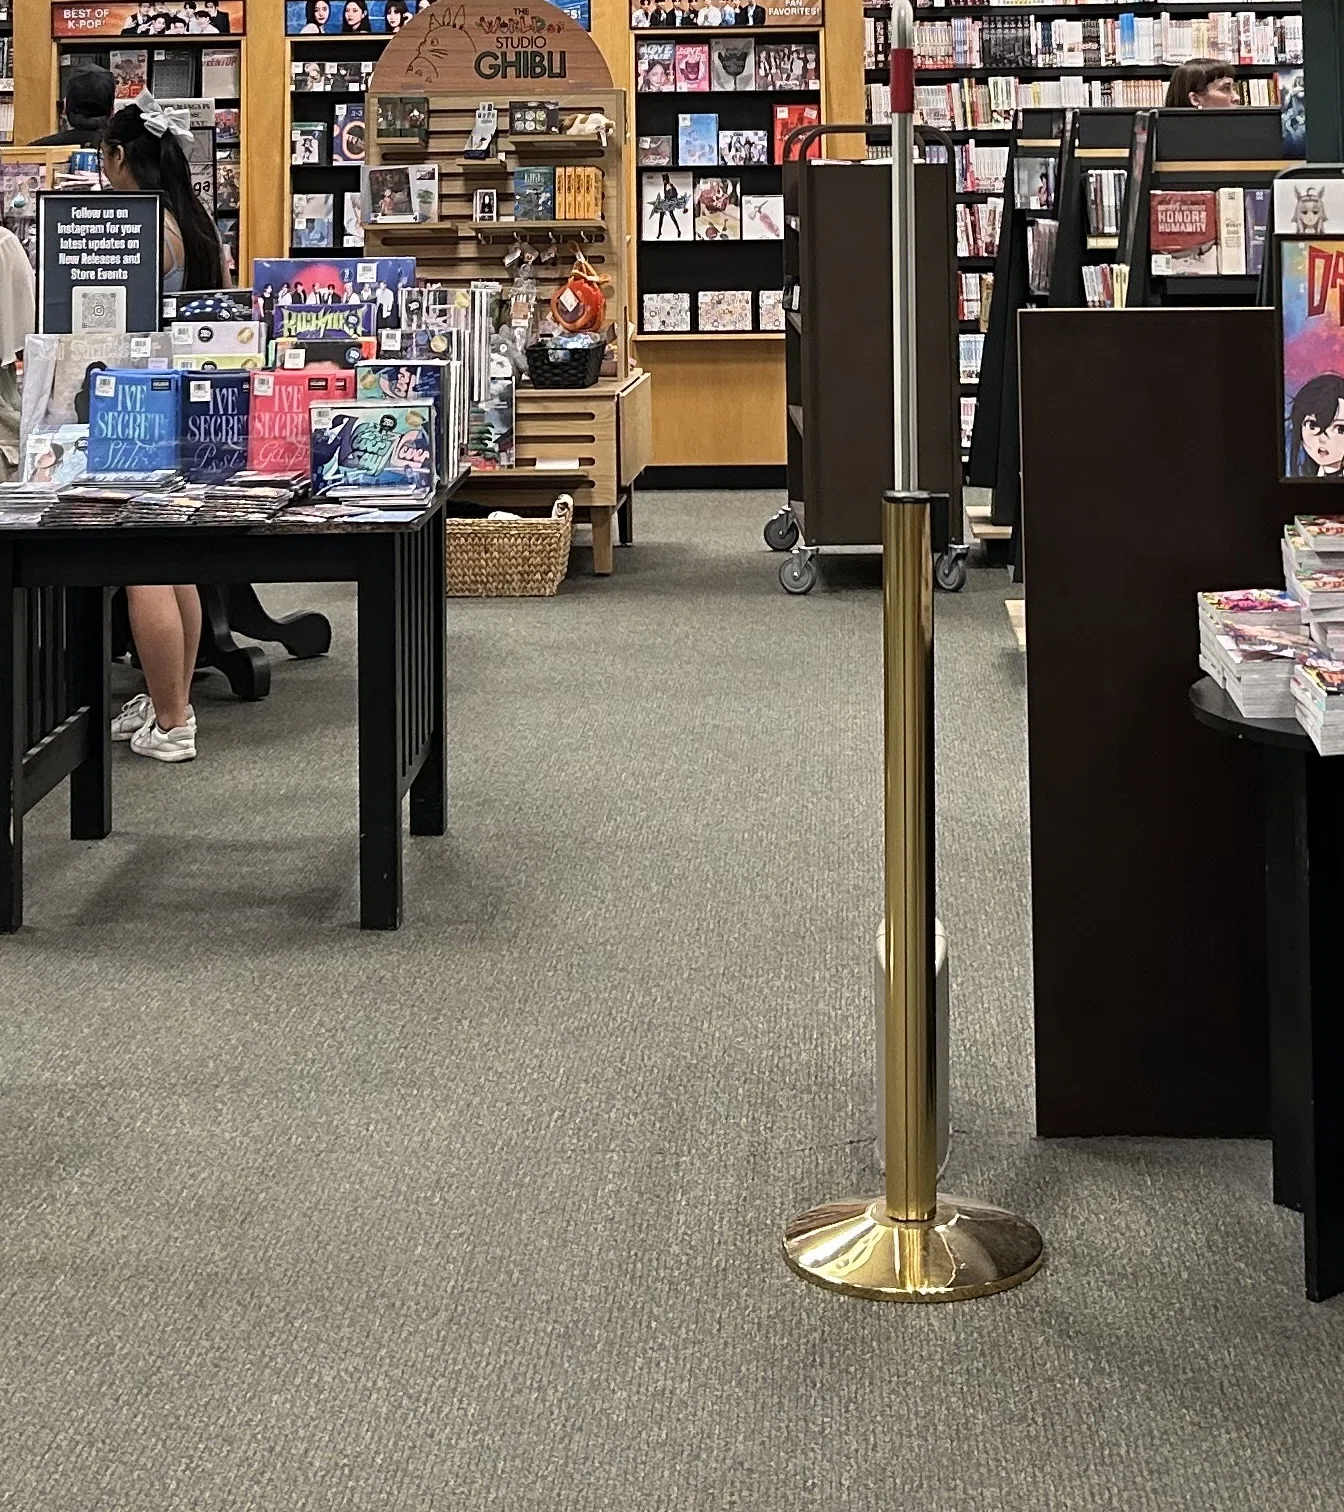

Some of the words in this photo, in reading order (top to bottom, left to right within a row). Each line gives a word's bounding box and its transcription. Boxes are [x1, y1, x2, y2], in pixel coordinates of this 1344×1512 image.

[63, 9, 93, 19] BEST
[94, 9, 110, 19] OF
[513, 7, 530, 16] THE
[768, 7, 820, 17] FAVORITES!
[67, 19, 106, 30] K-POP!
[495, 35, 547, 49] STUDIO
[473, 50, 567, 80] GHIBLI
[71, 207, 101, 220] Follow
[103, 209, 115, 220] us
[116, 209, 129, 220] on
[1157, 210, 1200, 223] HONOR
[57, 222, 104, 237] Instagram
[106, 222, 120, 235] for
[120, 224, 142, 237] your
[1158, 222, 1207, 233] HUMANITY
[60, 237, 87, 250] latest
[88, 237, 125, 251] updates
[127, 240, 140, 250] on
[58, 252, 80, 265] New
[80, 252, 121, 265] Releases
[122, 252, 141, 265] and
[70, 268, 96, 280] Store
[97, 268, 129, 280] Events
[116, 383, 147, 412] IVE
[207, 387, 238, 415] IVE
[273, 384, 305, 413] IVE
[94, 410, 166, 443] SECRET
